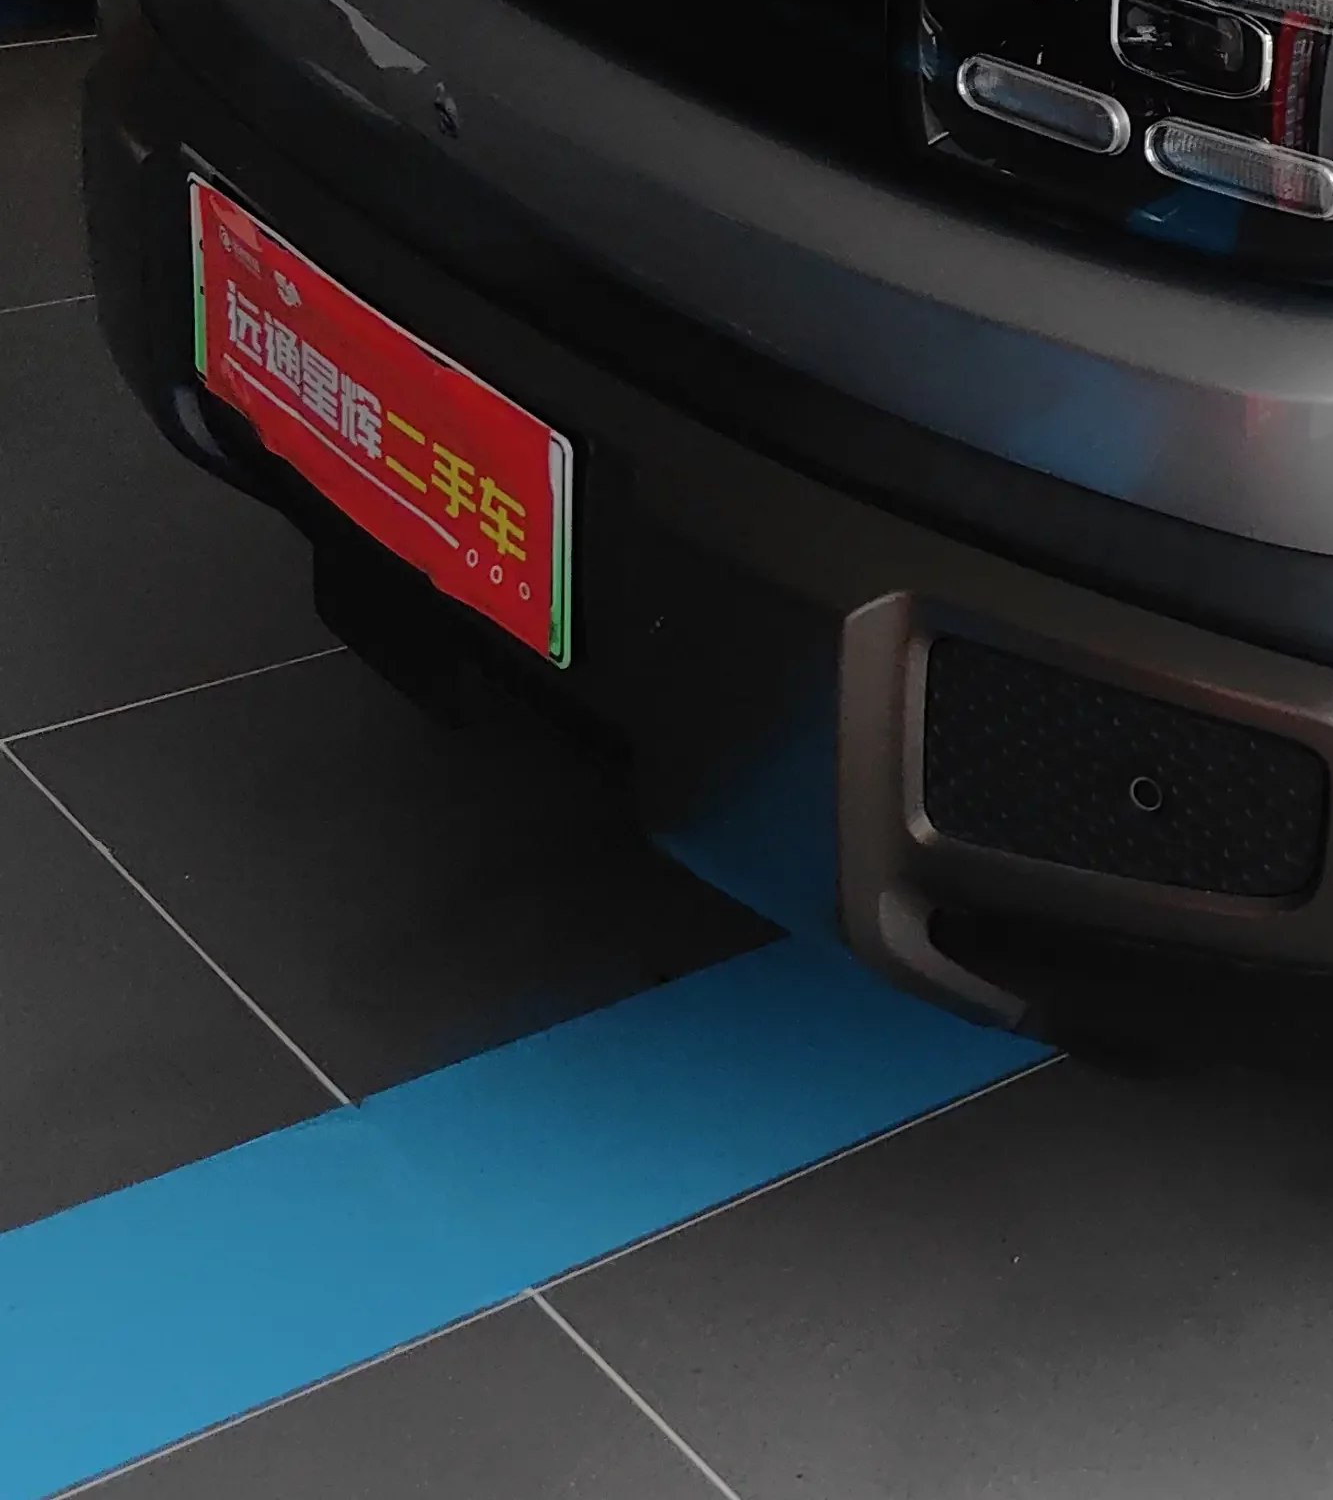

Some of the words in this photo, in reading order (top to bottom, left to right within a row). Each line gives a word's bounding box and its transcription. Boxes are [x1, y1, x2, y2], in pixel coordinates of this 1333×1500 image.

[226, 278, 527, 564] 远通星辉二手车
